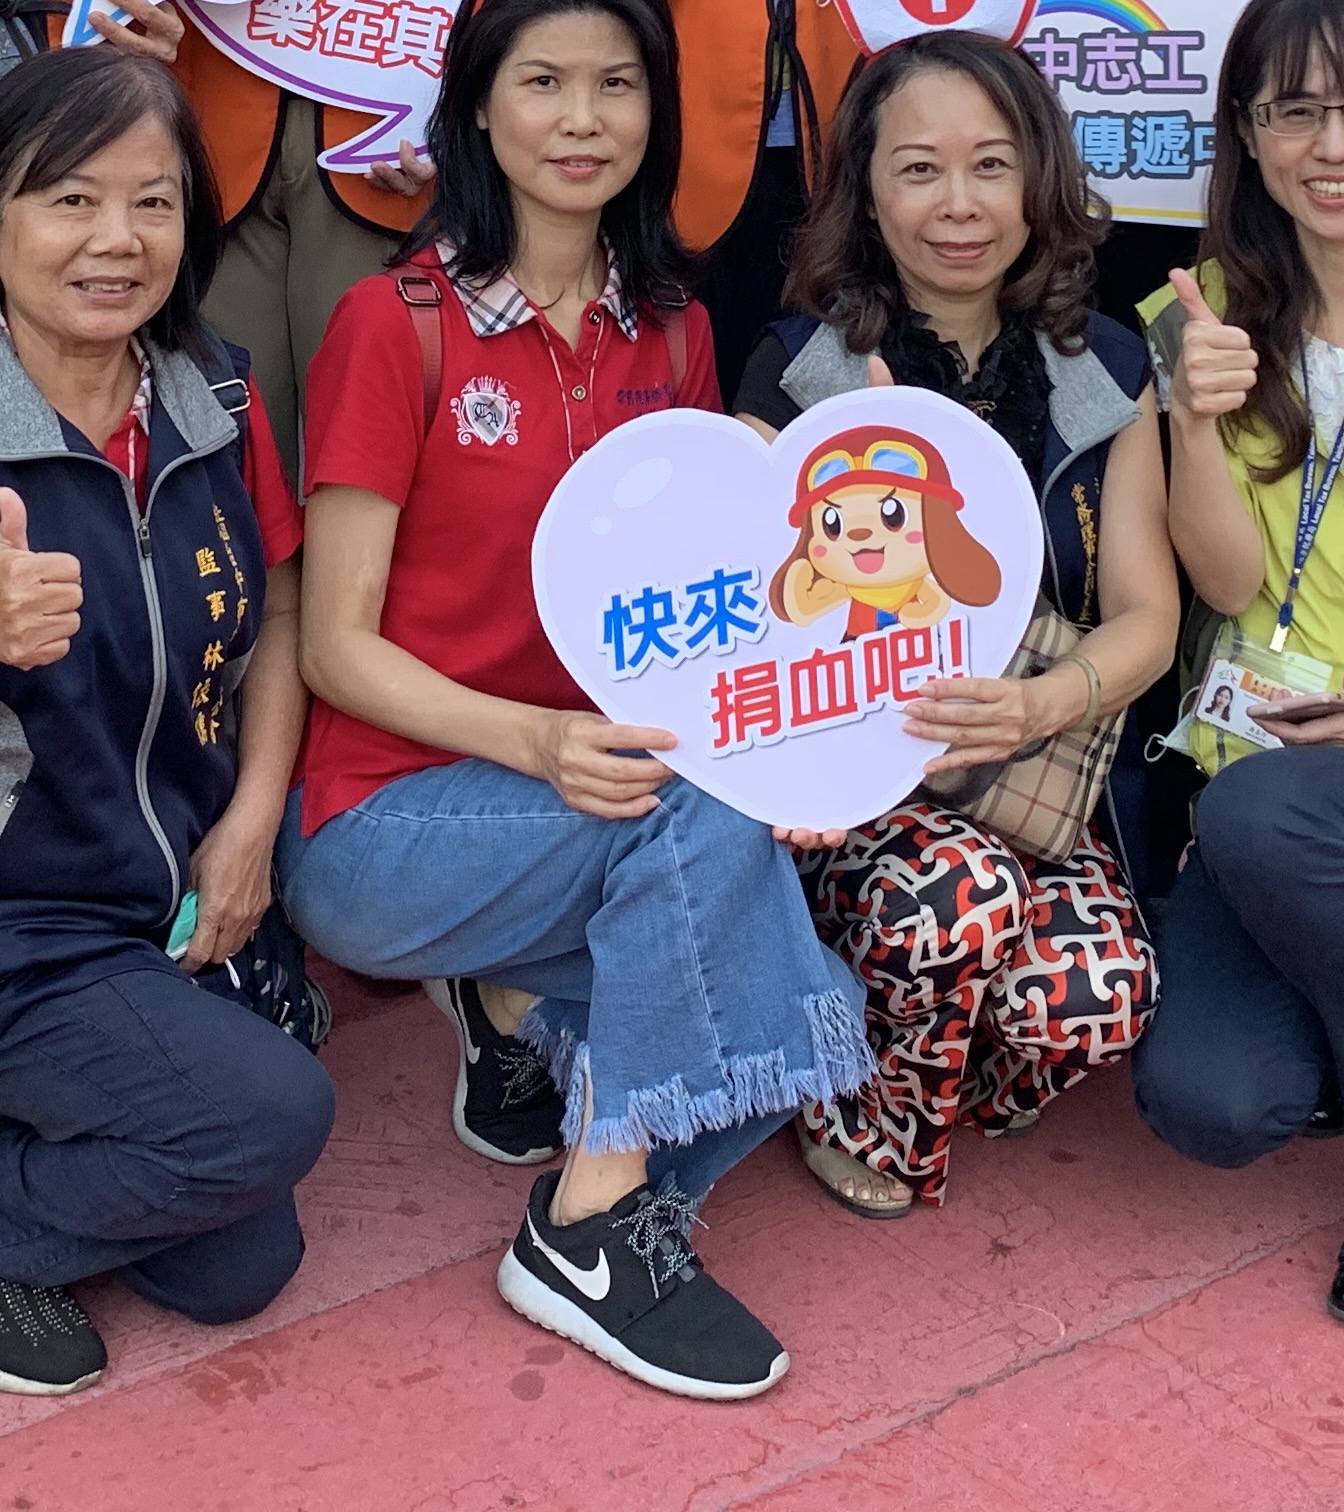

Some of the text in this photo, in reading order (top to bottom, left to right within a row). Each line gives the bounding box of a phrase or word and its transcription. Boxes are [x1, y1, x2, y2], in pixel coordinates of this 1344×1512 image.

[195, 547, 226, 622] 監事
[602, 567, 760, 672] 快來
[710, 619, 965, 750] 捐血吧!
